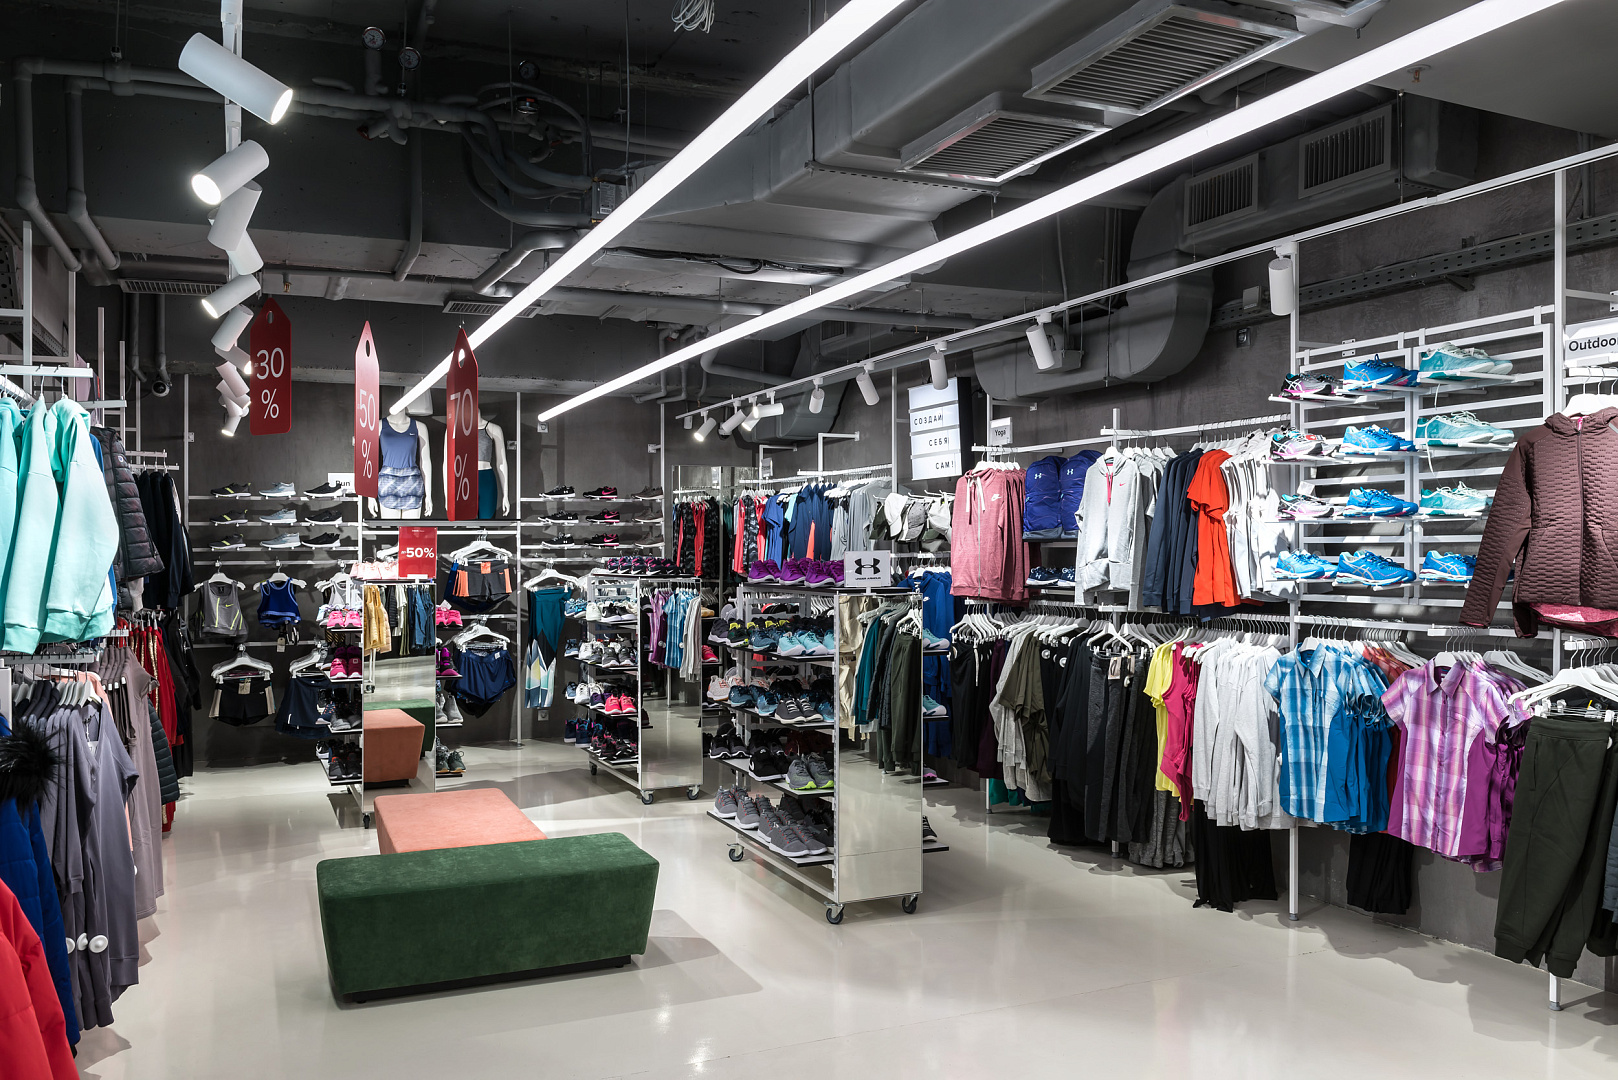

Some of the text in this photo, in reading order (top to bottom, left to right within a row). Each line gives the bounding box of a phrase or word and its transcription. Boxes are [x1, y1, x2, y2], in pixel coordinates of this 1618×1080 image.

[1568, 337, 1618, 351] Outdoo
[256, 347, 285, 380] 30
[261, 388, 280, 419] %
[359, 388, 376, 431] 50
[450, 388, 474, 439] 70
[913, 412, 943, 426] СОЗДАЙ
[928, 437, 948, 447] СЕБЯ
[994, 429, 1006, 438] Yoga
[361, 439, 373, 479] %
[935, 460, 954, 470] САМ!
[454, 453, 470, 501] %
